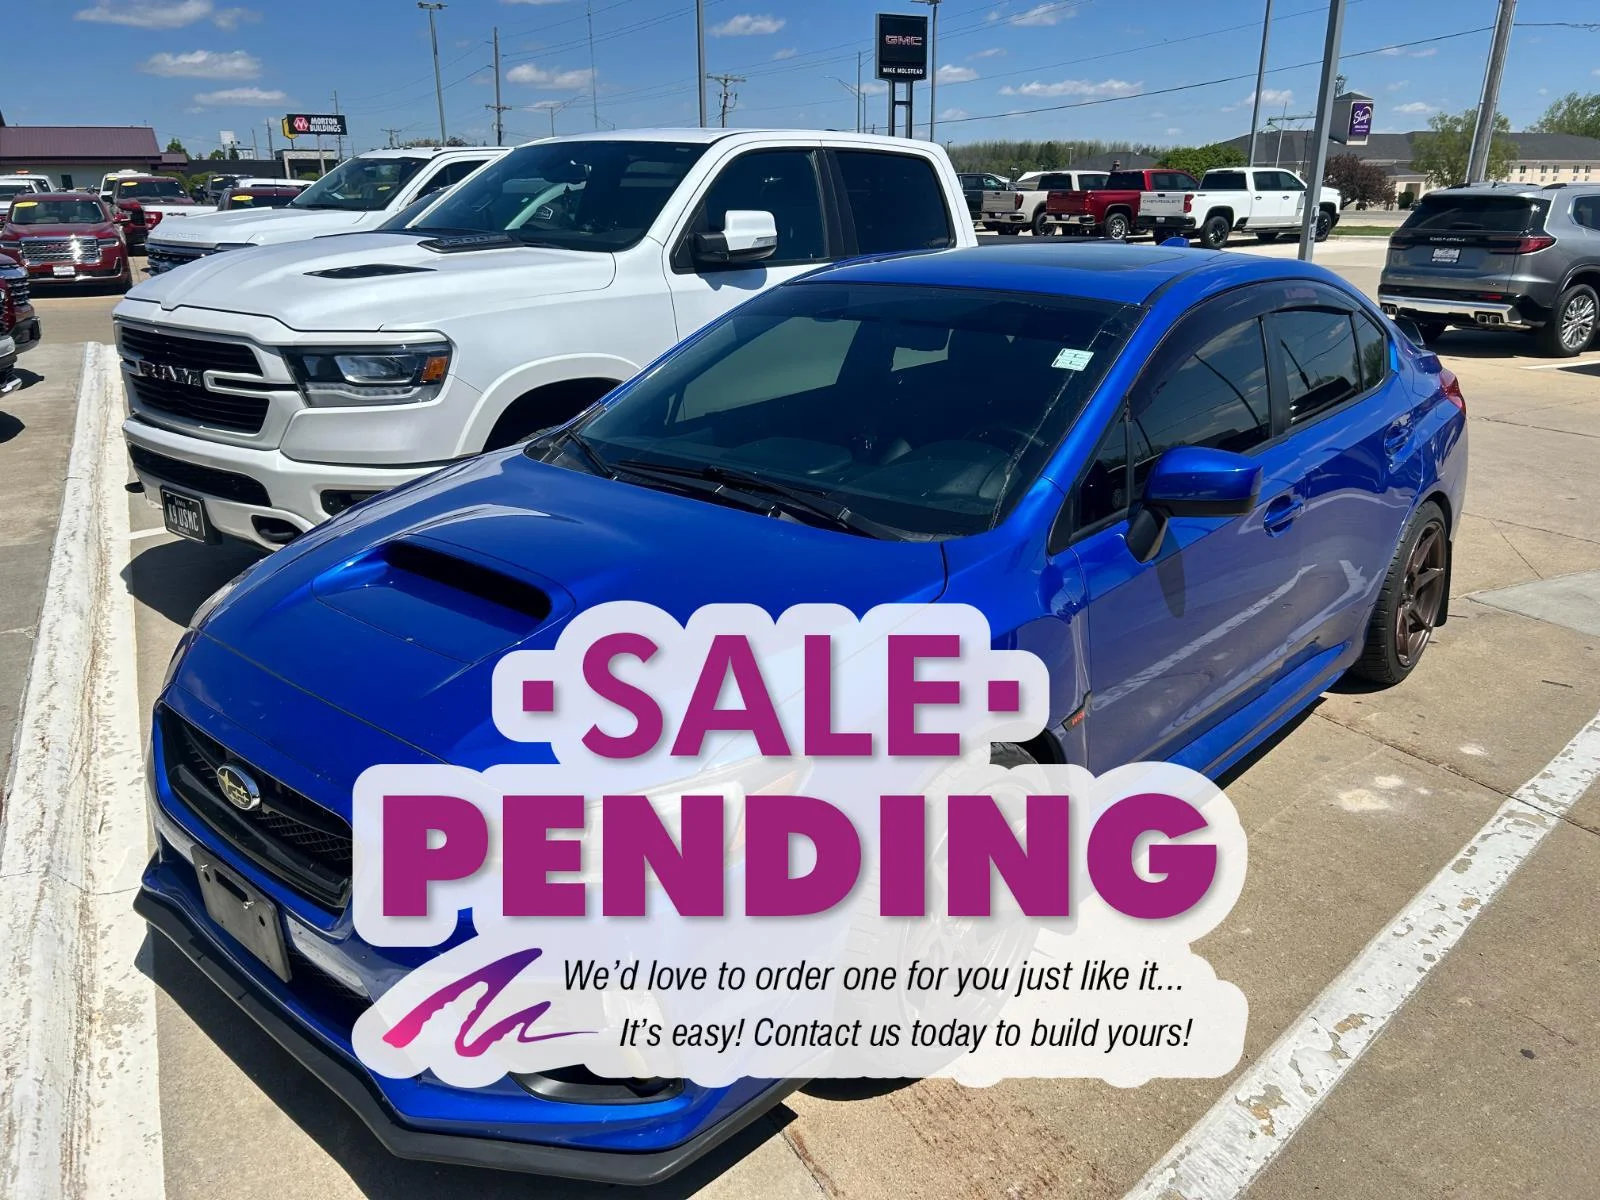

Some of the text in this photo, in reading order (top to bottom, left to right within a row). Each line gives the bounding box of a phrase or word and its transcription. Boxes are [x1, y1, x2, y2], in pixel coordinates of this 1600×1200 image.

[885, 34, 923, 46] GMC
[311, 117, 338, 125] MORTON
[310, 124, 342, 133] BUILDINGS
[137, 360, 203, 388] RAM
[177, 507, 199, 532] USMC
